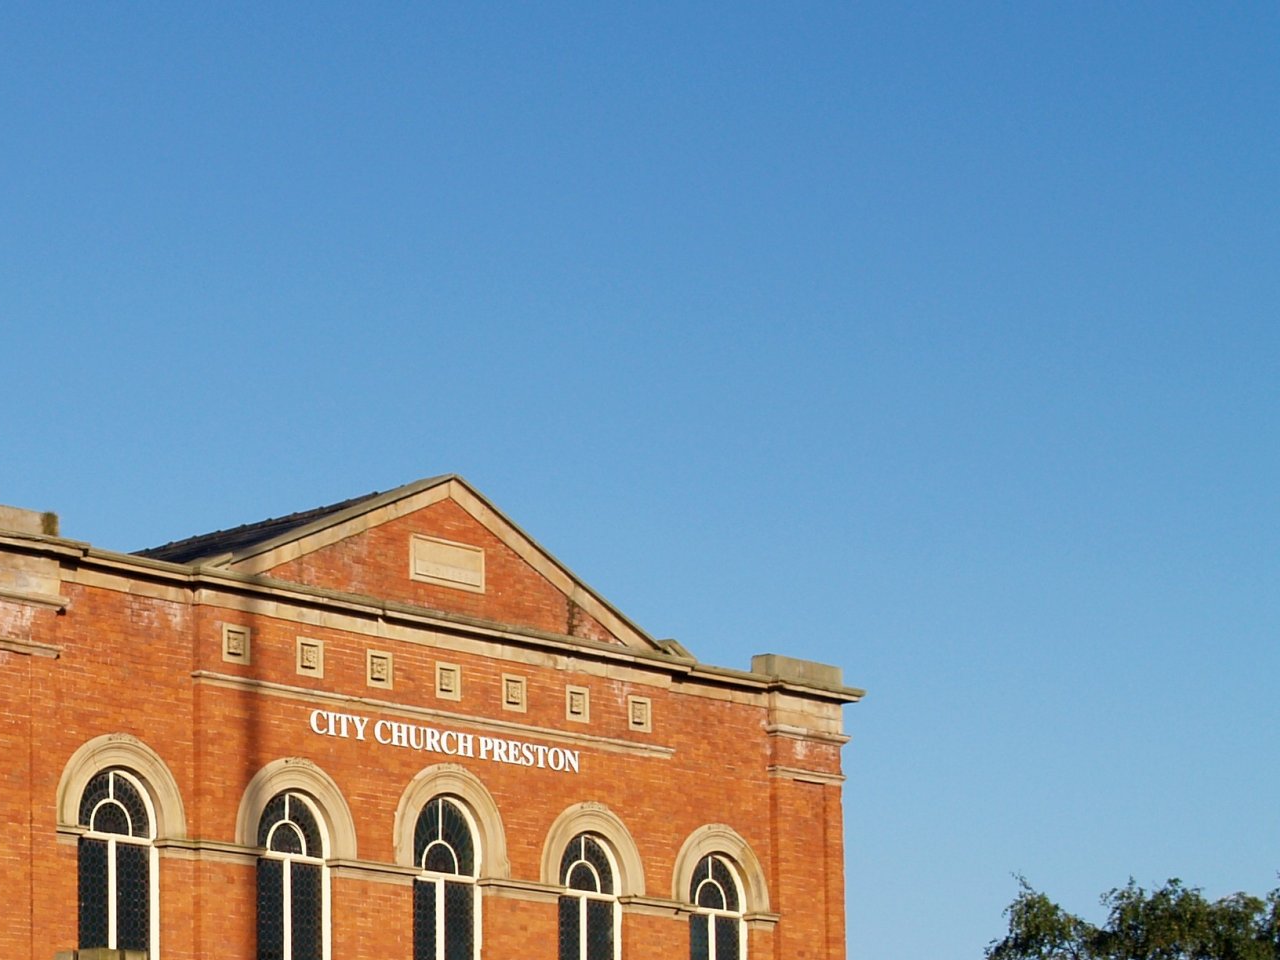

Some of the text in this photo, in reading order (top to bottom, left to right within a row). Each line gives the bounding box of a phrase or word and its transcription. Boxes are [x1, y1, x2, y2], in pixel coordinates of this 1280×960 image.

[309, 709, 580, 774] CITY CHURCH PRESTON
